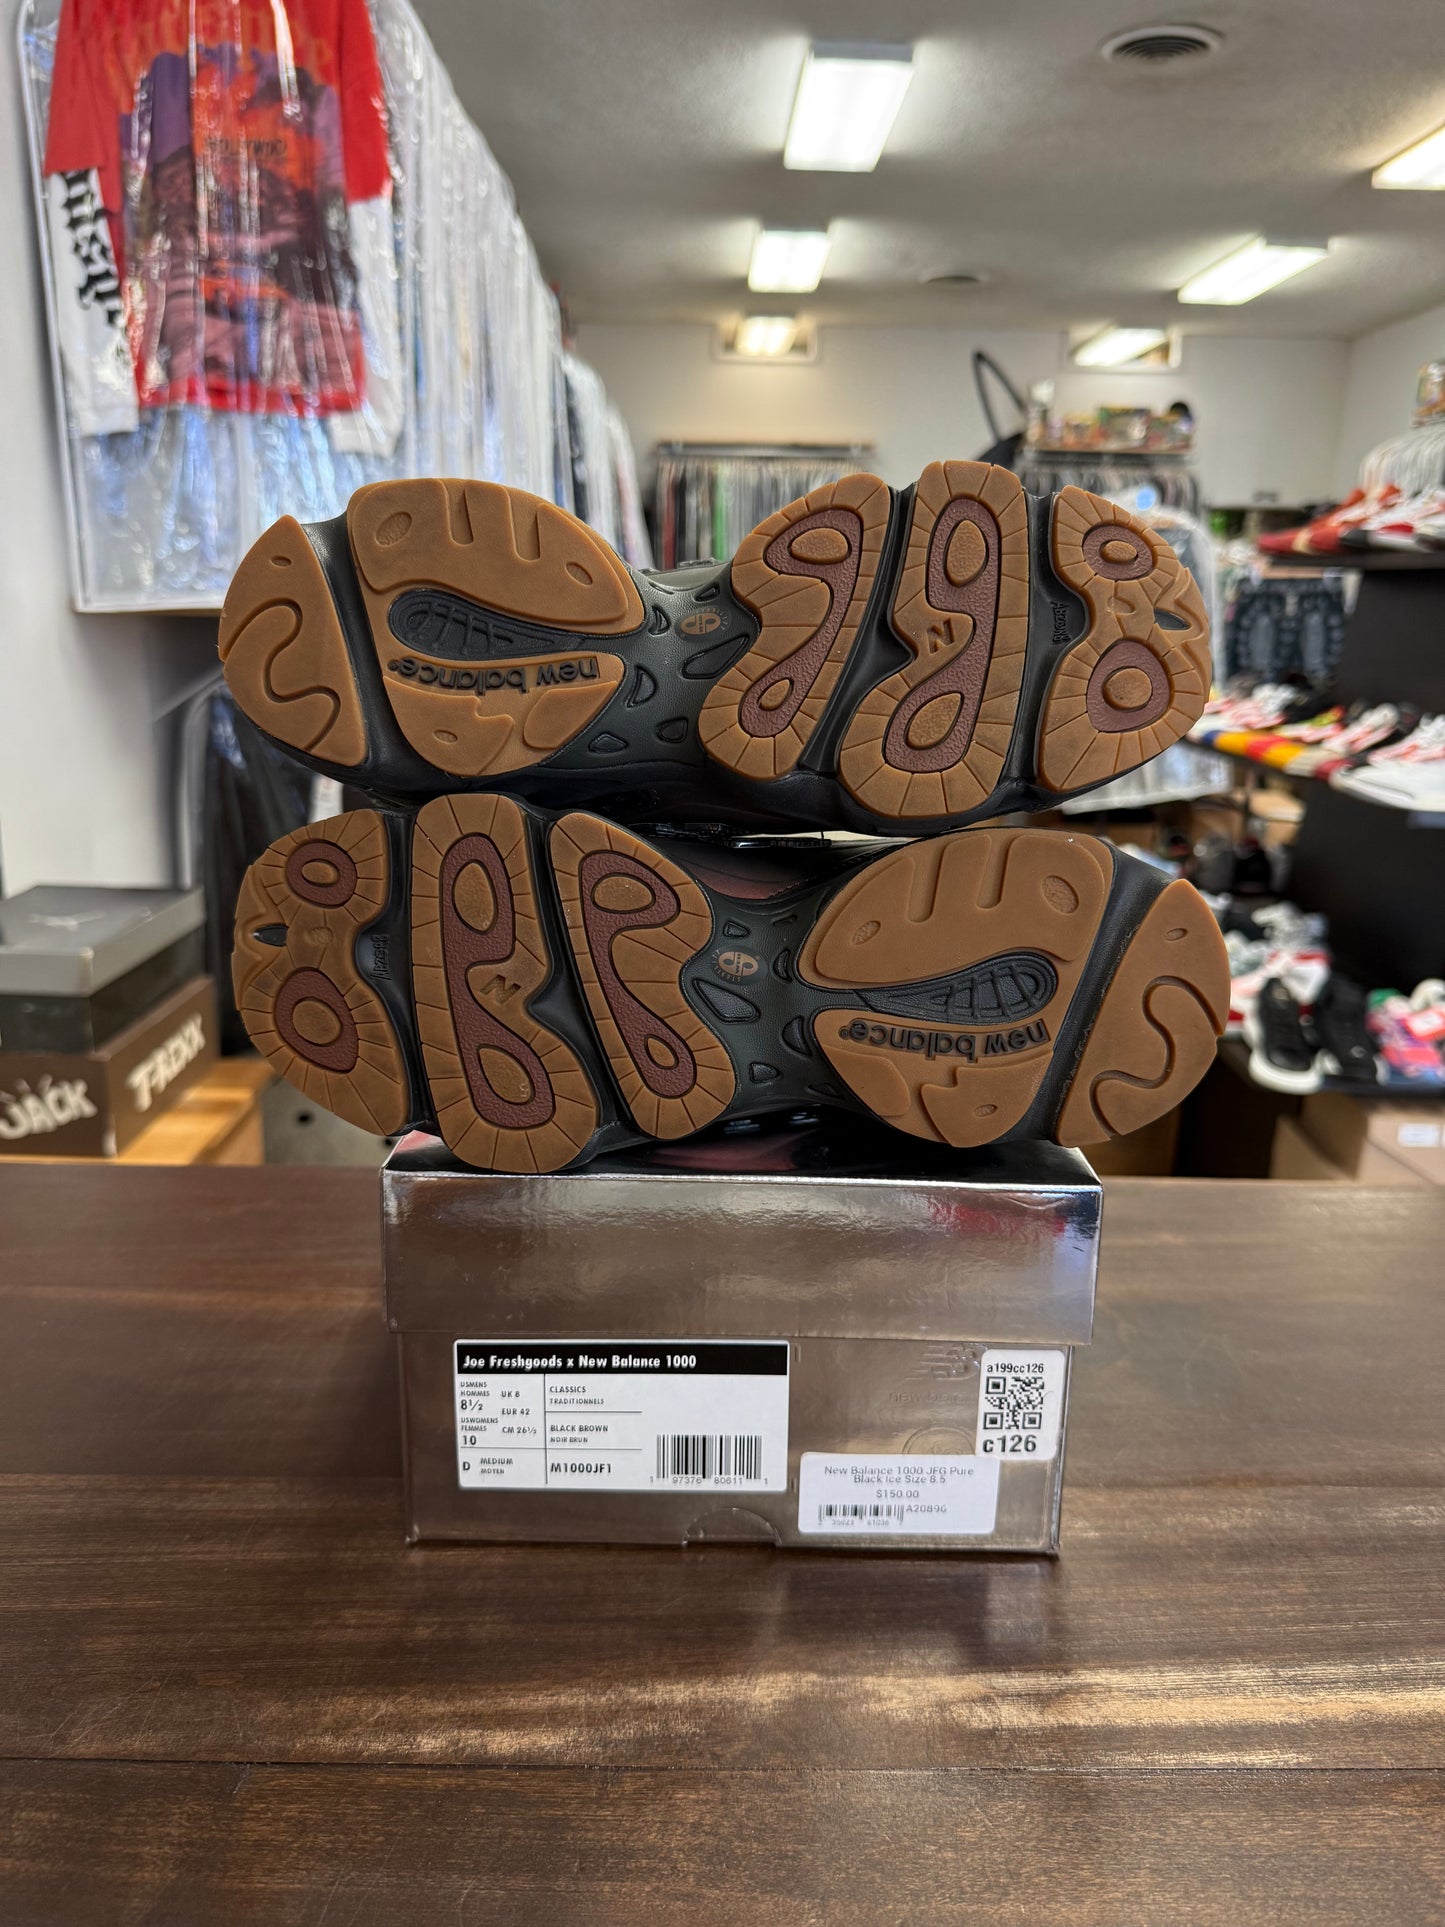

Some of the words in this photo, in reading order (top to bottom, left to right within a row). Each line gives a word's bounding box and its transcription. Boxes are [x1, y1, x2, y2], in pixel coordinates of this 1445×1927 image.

[536, 653, 597, 686] new
[400, 656, 527, 694] balance
[850, 1020, 976, 1060] balance
[984, 1021, 1047, 1055] new
[463, 1355, 485, 1368] Joe
[490, 1355, 562, 1371] Freshgoods
[566, 1358, 574, 1367] x
[578, 1355, 607, 1368] New
[612, 1355, 661, 1368] Balance
[666, 1355, 697, 1368] 1000
[987, 1363, 1044, 1373] a199cc126
[501, 1390, 513, 1398] UK
[515, 1390, 521, 1398] 8
[502, 1426, 514, 1434] CM
[550, 1424, 576, 1432] BLACK
[462, 1435, 477, 1446] 10
[983, 1434, 1037, 1453] c126
[462, 1461, 471, 1471] D
[480, 1457, 513, 1465] MEDIUM
[550, 1462, 612, 1473] M1000JF1
[824, 1466, 847, 1475] New
[851, 1466, 893, 1475] Balance
[897, 1466, 923, 1475] 1000
[926, 1466, 947, 1475] JFG
[949, 1466, 974, 1475] Pure
[672, 1476, 702, 1485] 97376
[713, 1476, 743, 1485] 80611
[853, 1475, 884, 1484] Black
[885, 1475, 901, 1484] Ice
[904, 1475, 927, 1484] Size
[929, 1475, 946, 1484] 8.5
[876, 1489, 920, 1499] $150.00
